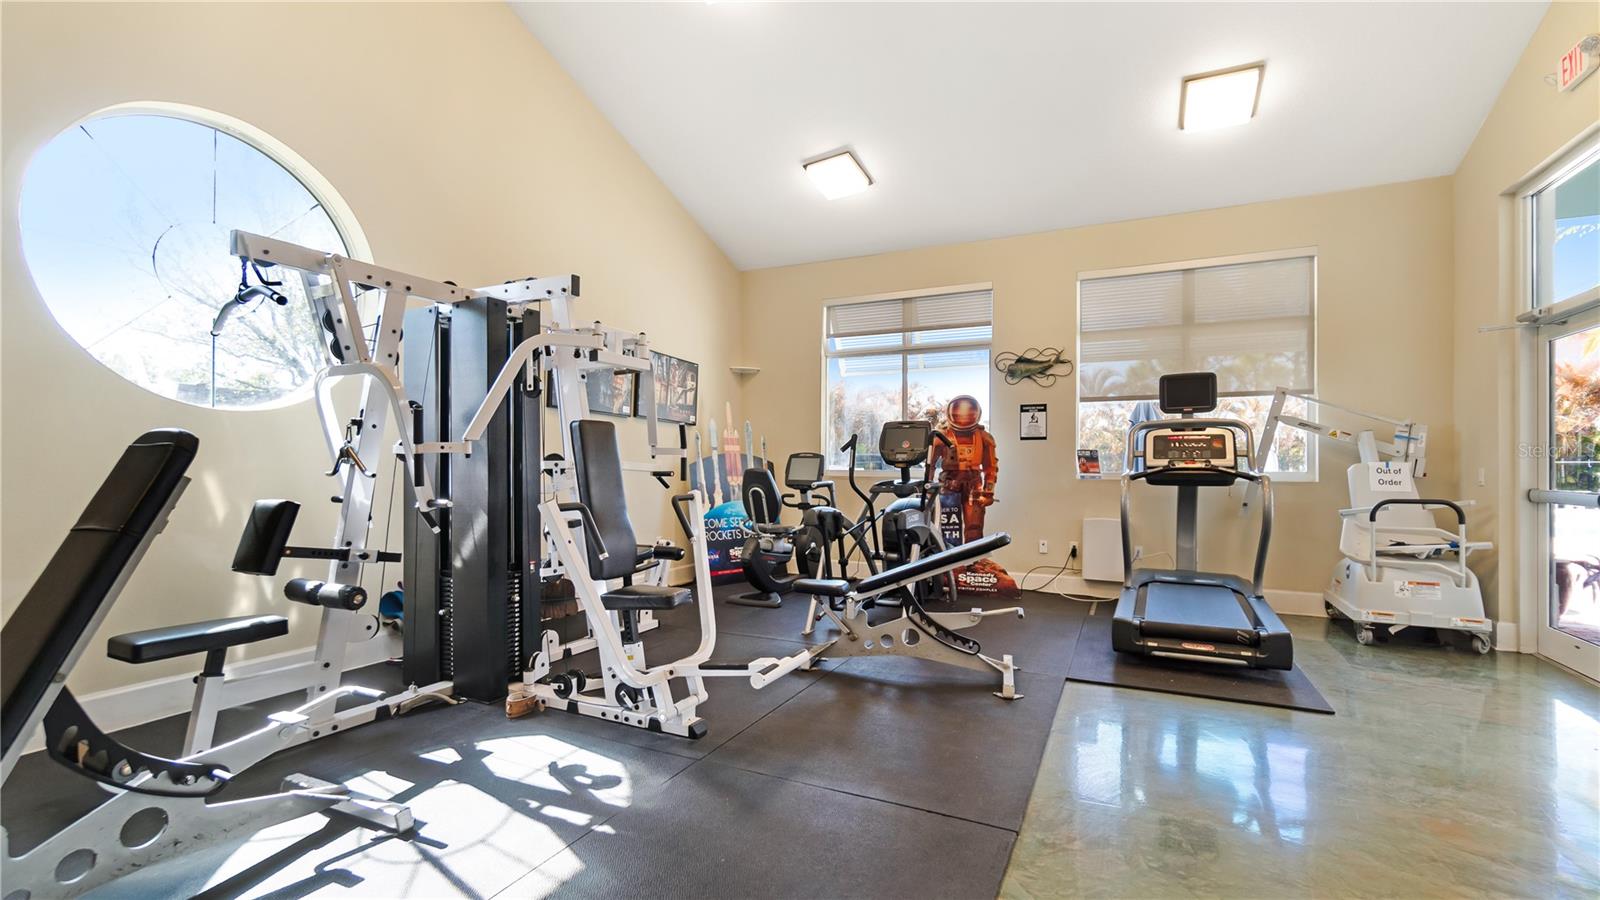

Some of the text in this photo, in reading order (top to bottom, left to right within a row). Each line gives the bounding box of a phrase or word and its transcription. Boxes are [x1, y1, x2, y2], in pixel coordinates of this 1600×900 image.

[1562, 43, 1583, 86] EXIT
[1376, 467, 1402, 475] Out of
[1378, 478, 1402, 486] Order
[704, 518, 729, 529] COME
[940, 514, 959, 524] SA
[705, 529, 742, 541] ROCKETS
[944, 531, 960, 539] TH
[958, 573, 998, 584] Space
